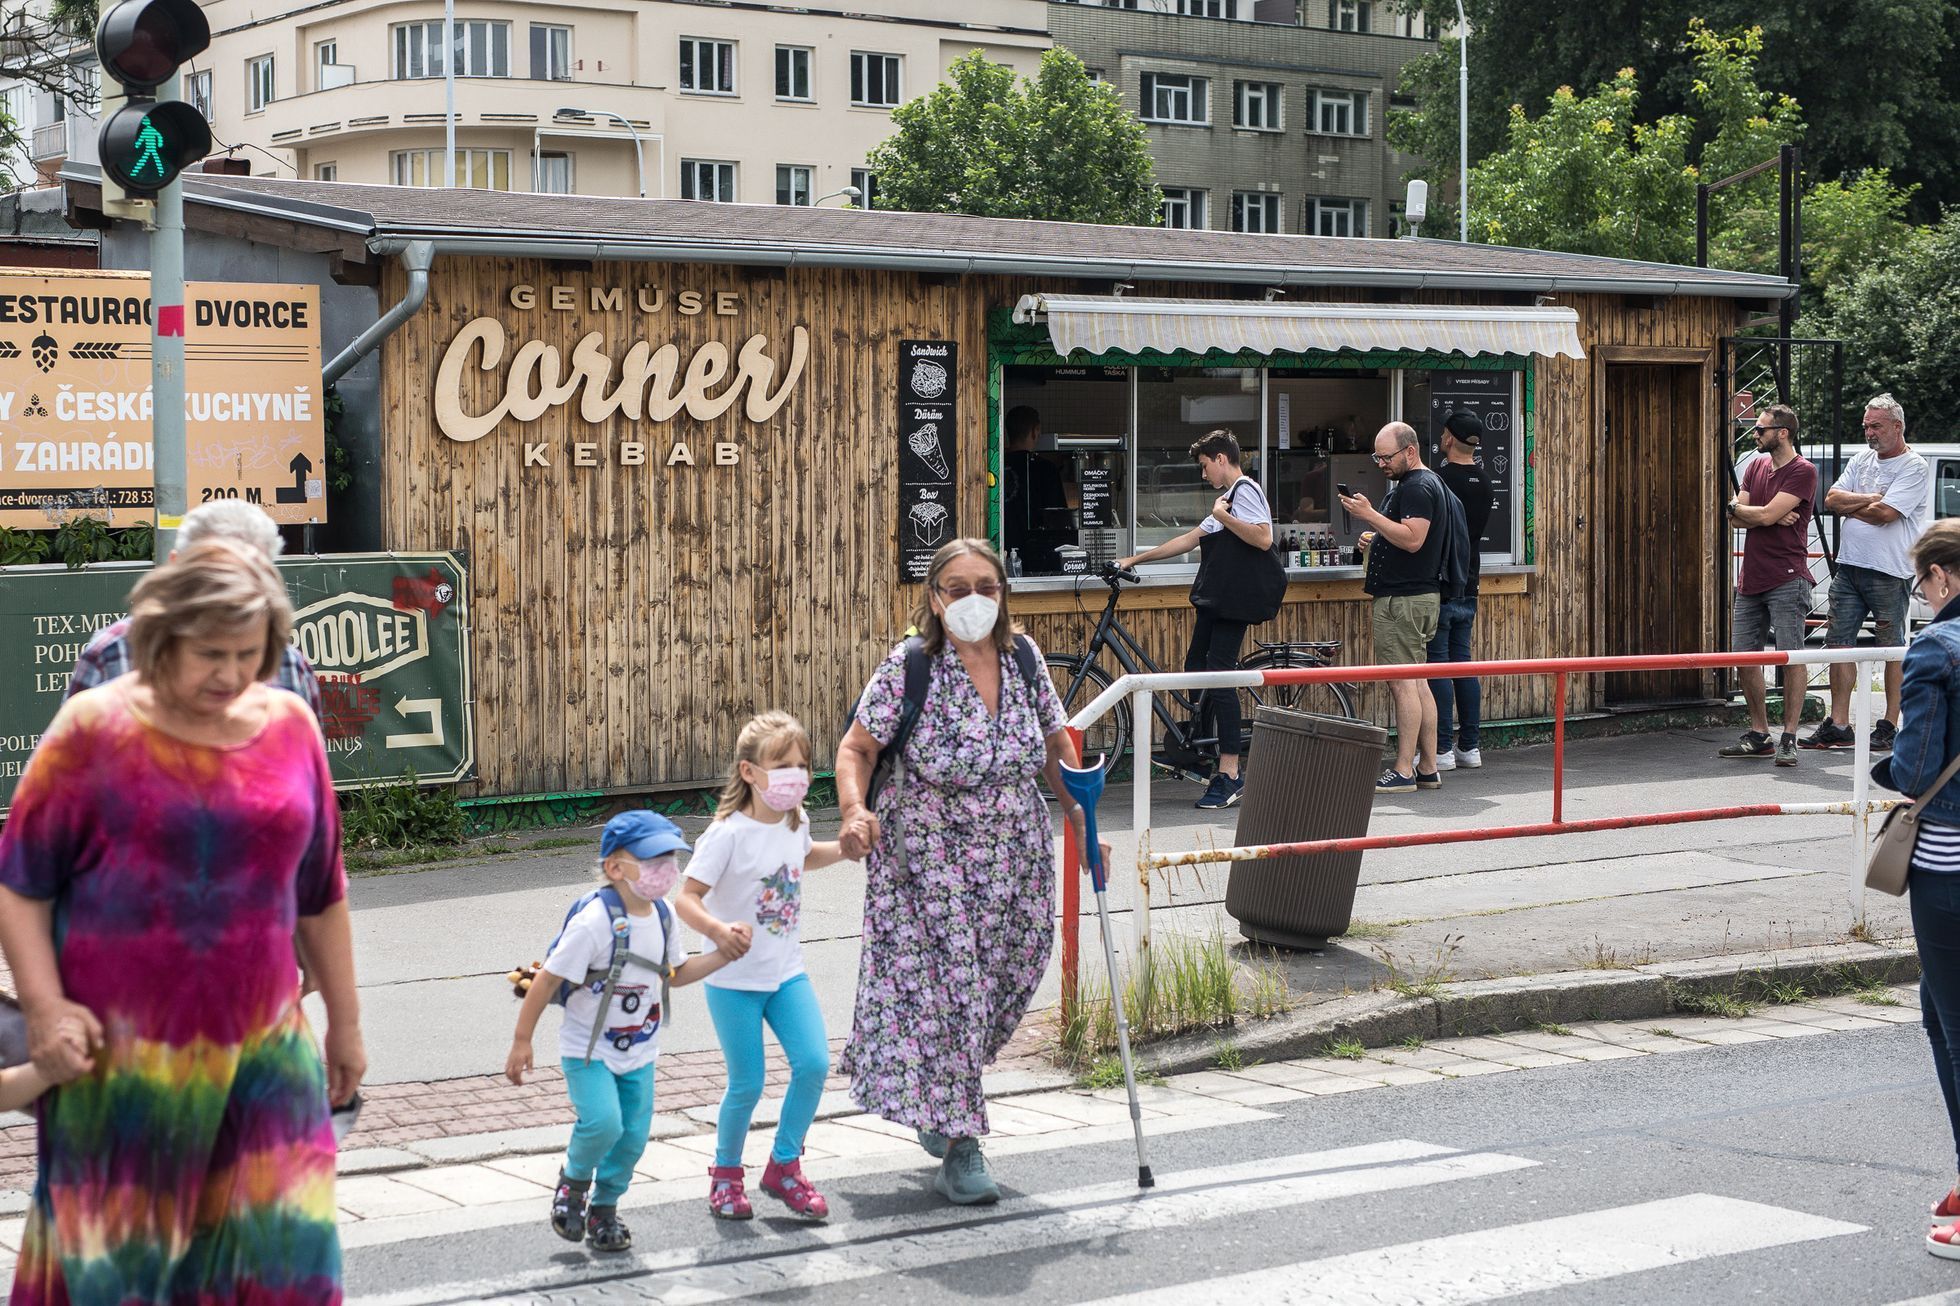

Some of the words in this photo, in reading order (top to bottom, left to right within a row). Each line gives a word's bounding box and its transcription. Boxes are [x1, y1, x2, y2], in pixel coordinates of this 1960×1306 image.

[510, 283, 739, 316] GEMÜSE
[195, 300, 309, 328] DVORCE
[910, 344, 949, 357] Sandwich
[435, 317, 810, 442] Corner
[55, 383, 154, 422] ČESKÁ
[523, 442, 740, 467] KEBAB
[118, 490, 139, 504] 728
[140, 490, 154, 504] 53
[201, 487, 239, 503] 200
[245, 487, 262, 504] M
[919, 488, 939, 500] Box
[322, 735, 363, 754] INUS
